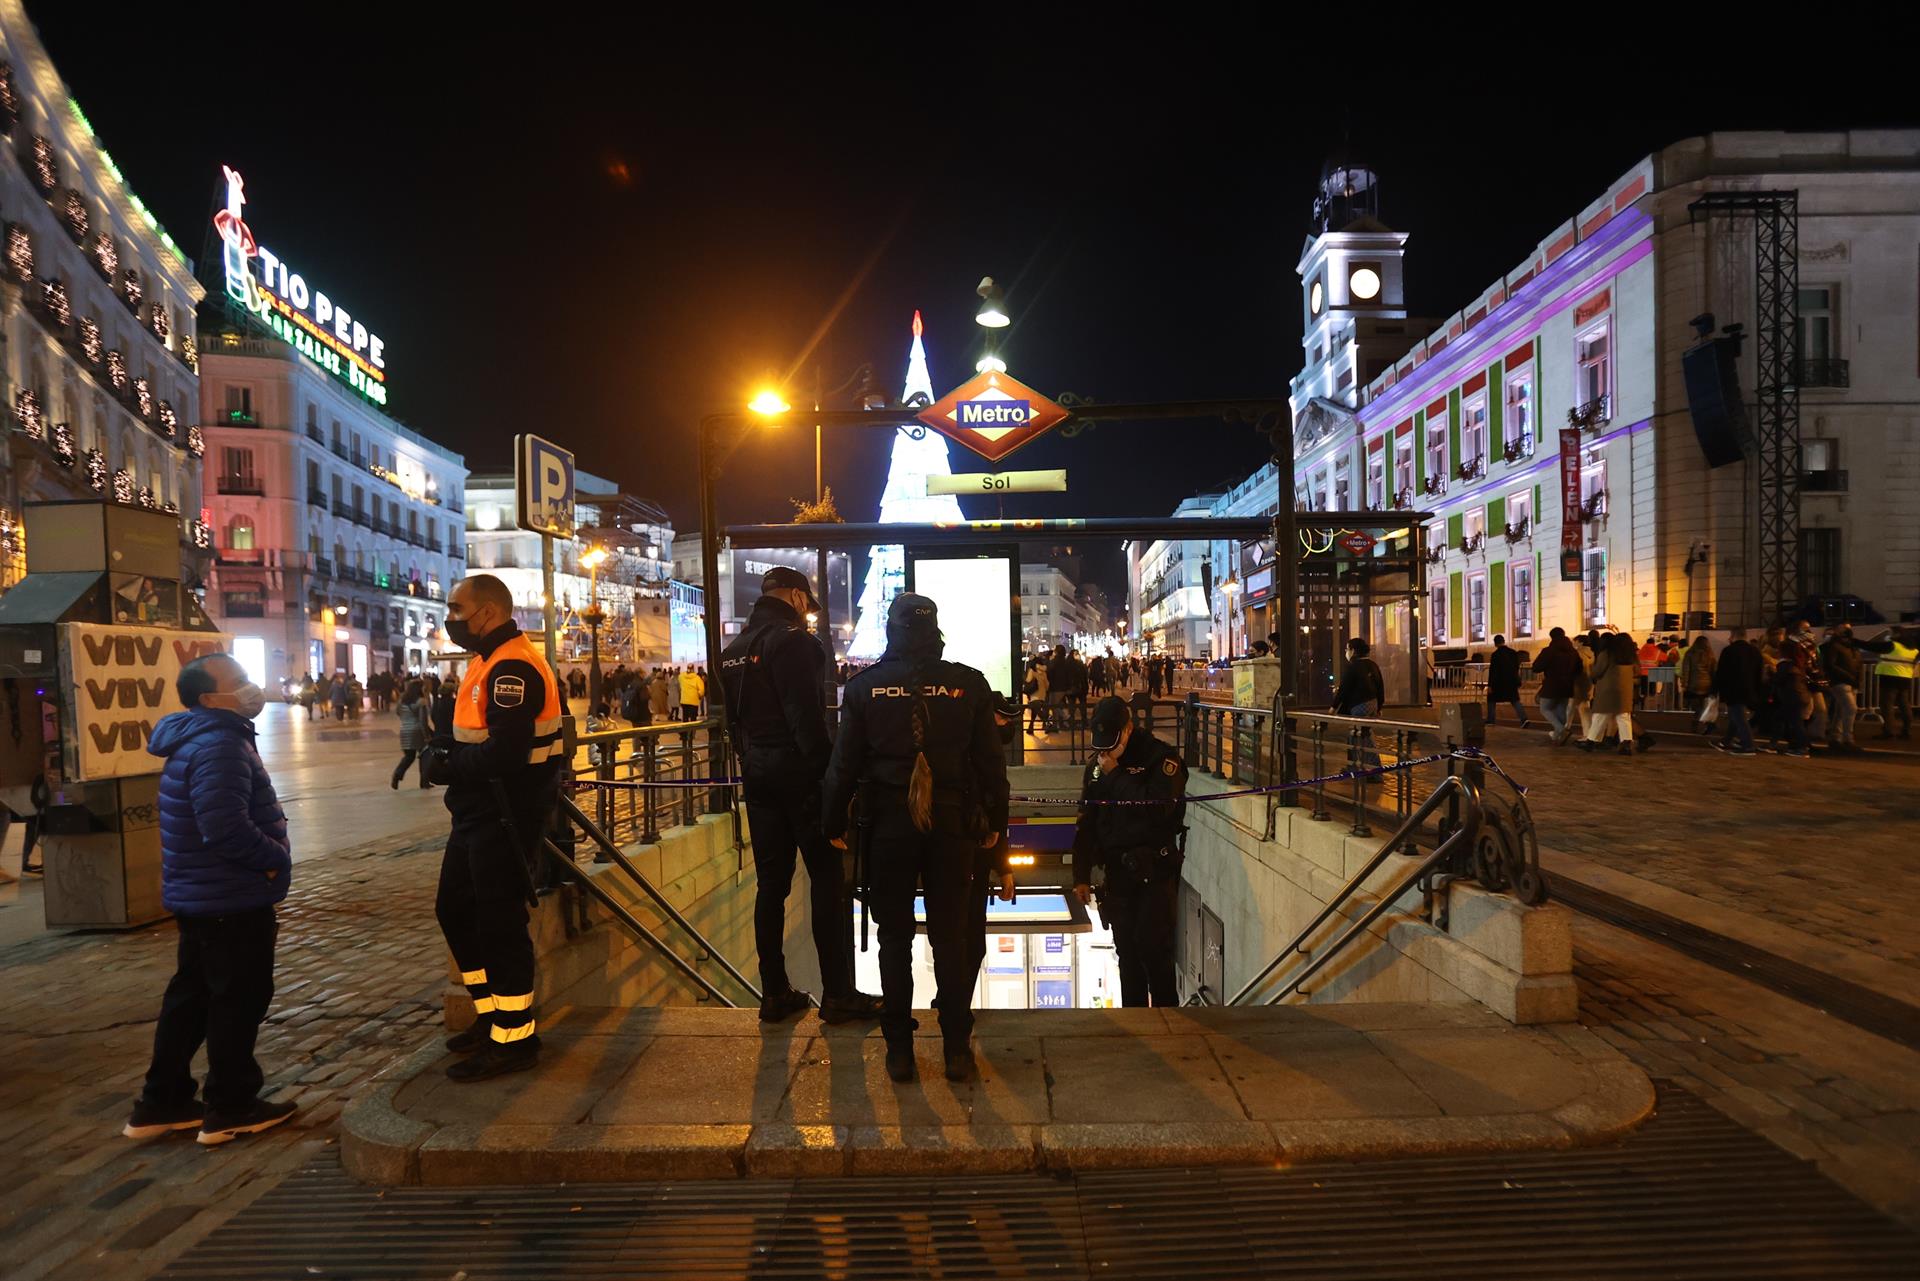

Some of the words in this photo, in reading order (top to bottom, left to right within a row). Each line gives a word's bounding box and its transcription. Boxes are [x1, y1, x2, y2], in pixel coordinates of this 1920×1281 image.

[258, 246, 309, 310] TIO
[315, 291, 385, 368] PEPE
[963, 404, 1025, 423] Metro
[540, 449, 567, 519] P
[982, 476, 1011, 490] Sol
[496, 685, 523, 694] Trablisa
[872, 685, 949, 698] POLCIA
